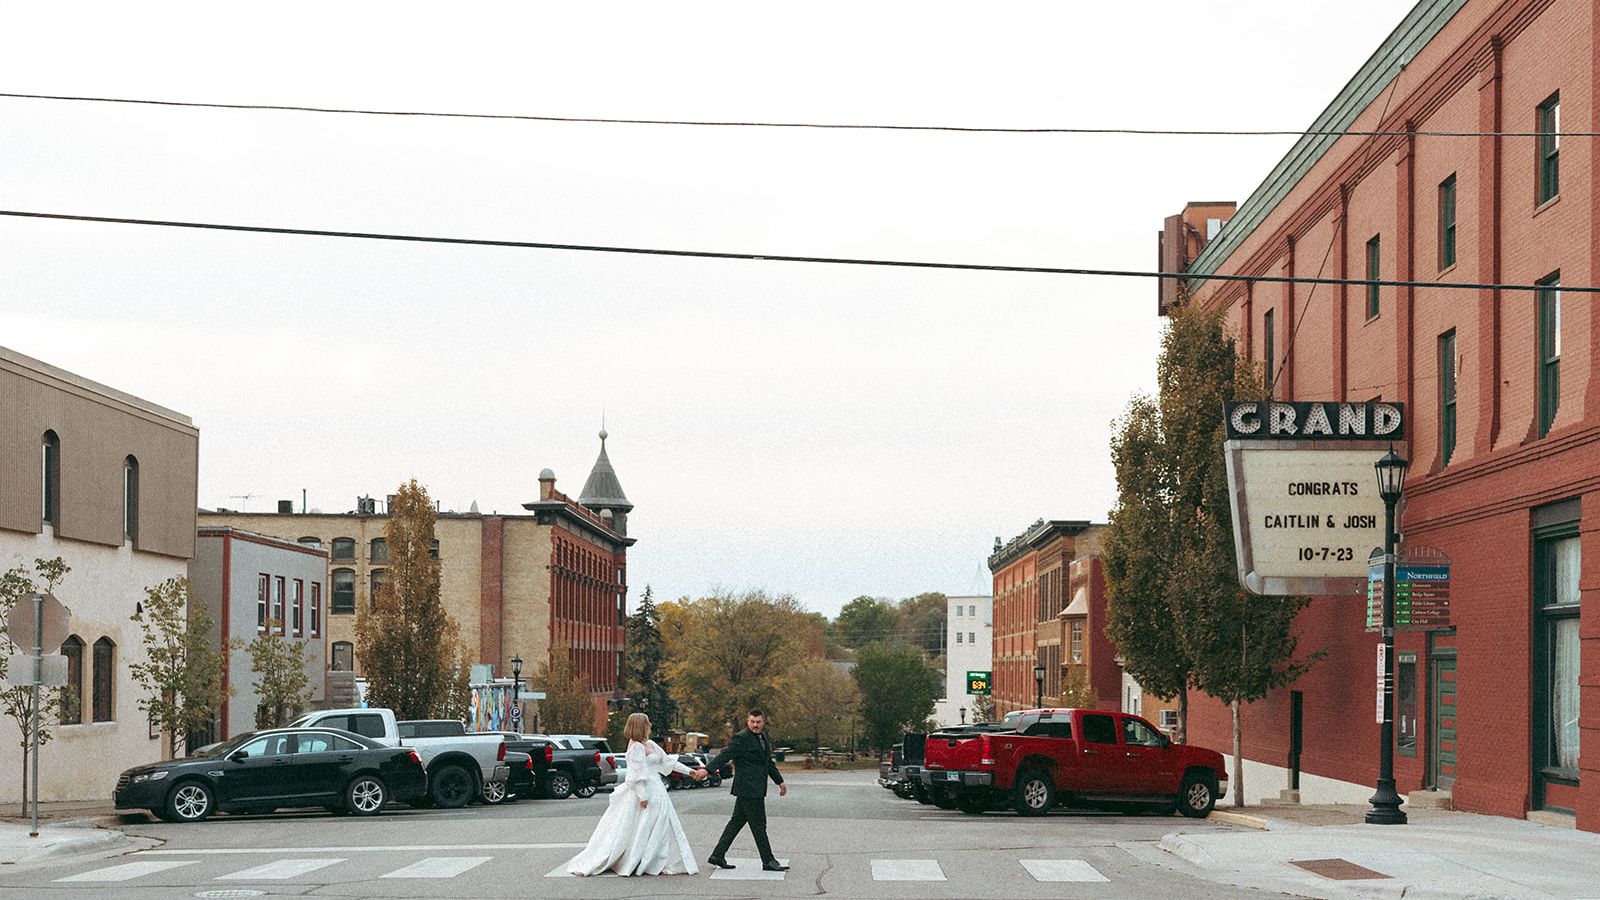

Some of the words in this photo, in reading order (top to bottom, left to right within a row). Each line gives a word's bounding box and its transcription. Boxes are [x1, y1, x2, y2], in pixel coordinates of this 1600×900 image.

[1230, 402, 1402, 436] GRAND
[1288, 482, 1359, 496] CONGRATS
[1264, 515, 1320, 529] CAITLIN
[1326, 515, 1336, 529] &
[1344, 515, 1377, 529] JOSH
[1298, 547, 1354, 561] 10-7-23
